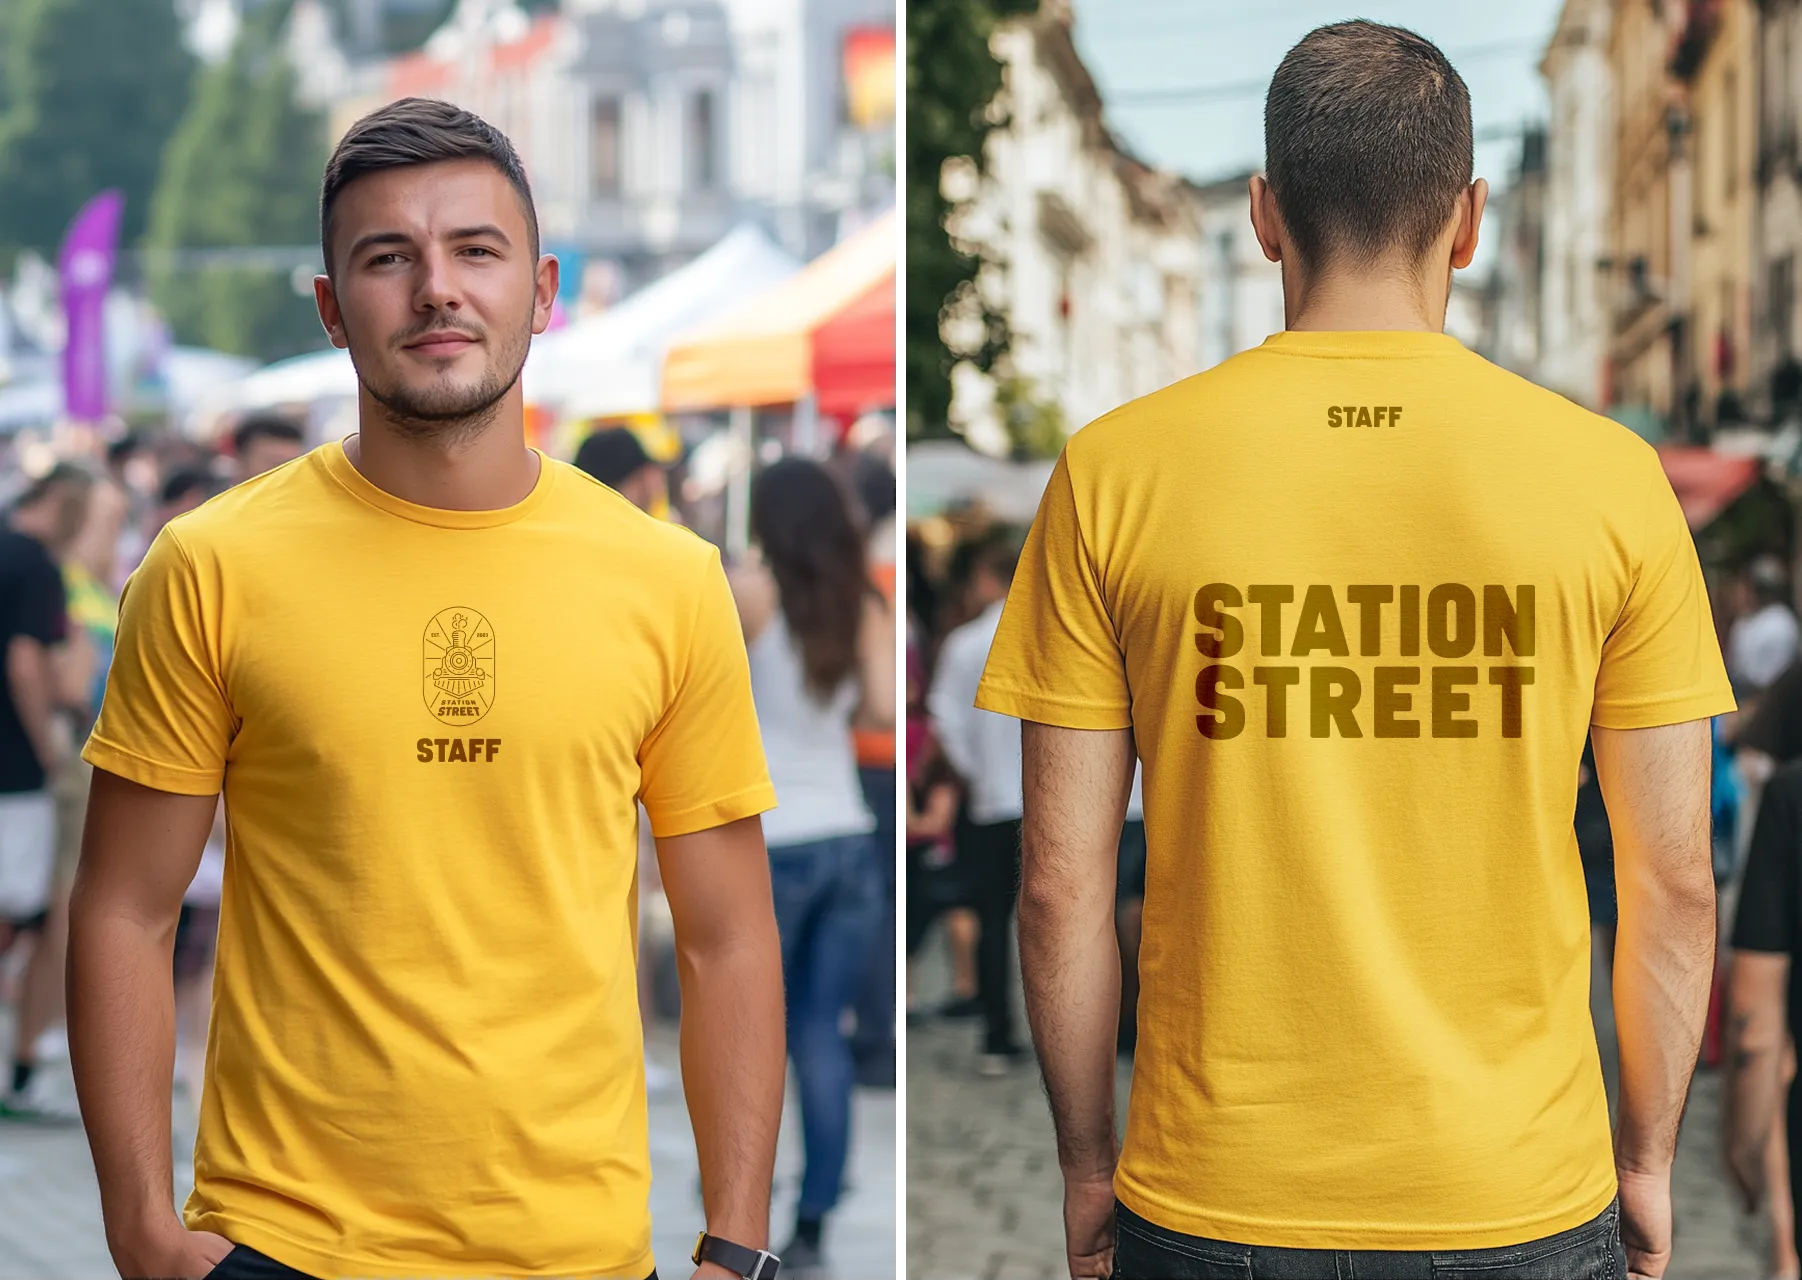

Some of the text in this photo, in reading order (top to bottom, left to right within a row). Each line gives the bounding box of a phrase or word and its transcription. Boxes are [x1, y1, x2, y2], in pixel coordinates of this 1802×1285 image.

[1328, 406, 1402, 428] STAFF
[1194, 583, 1535, 658] STATION
[438, 707, 480, 716] STREET
[1195, 665, 1535, 740] STREET
[417, 738, 501, 763] STAFF
